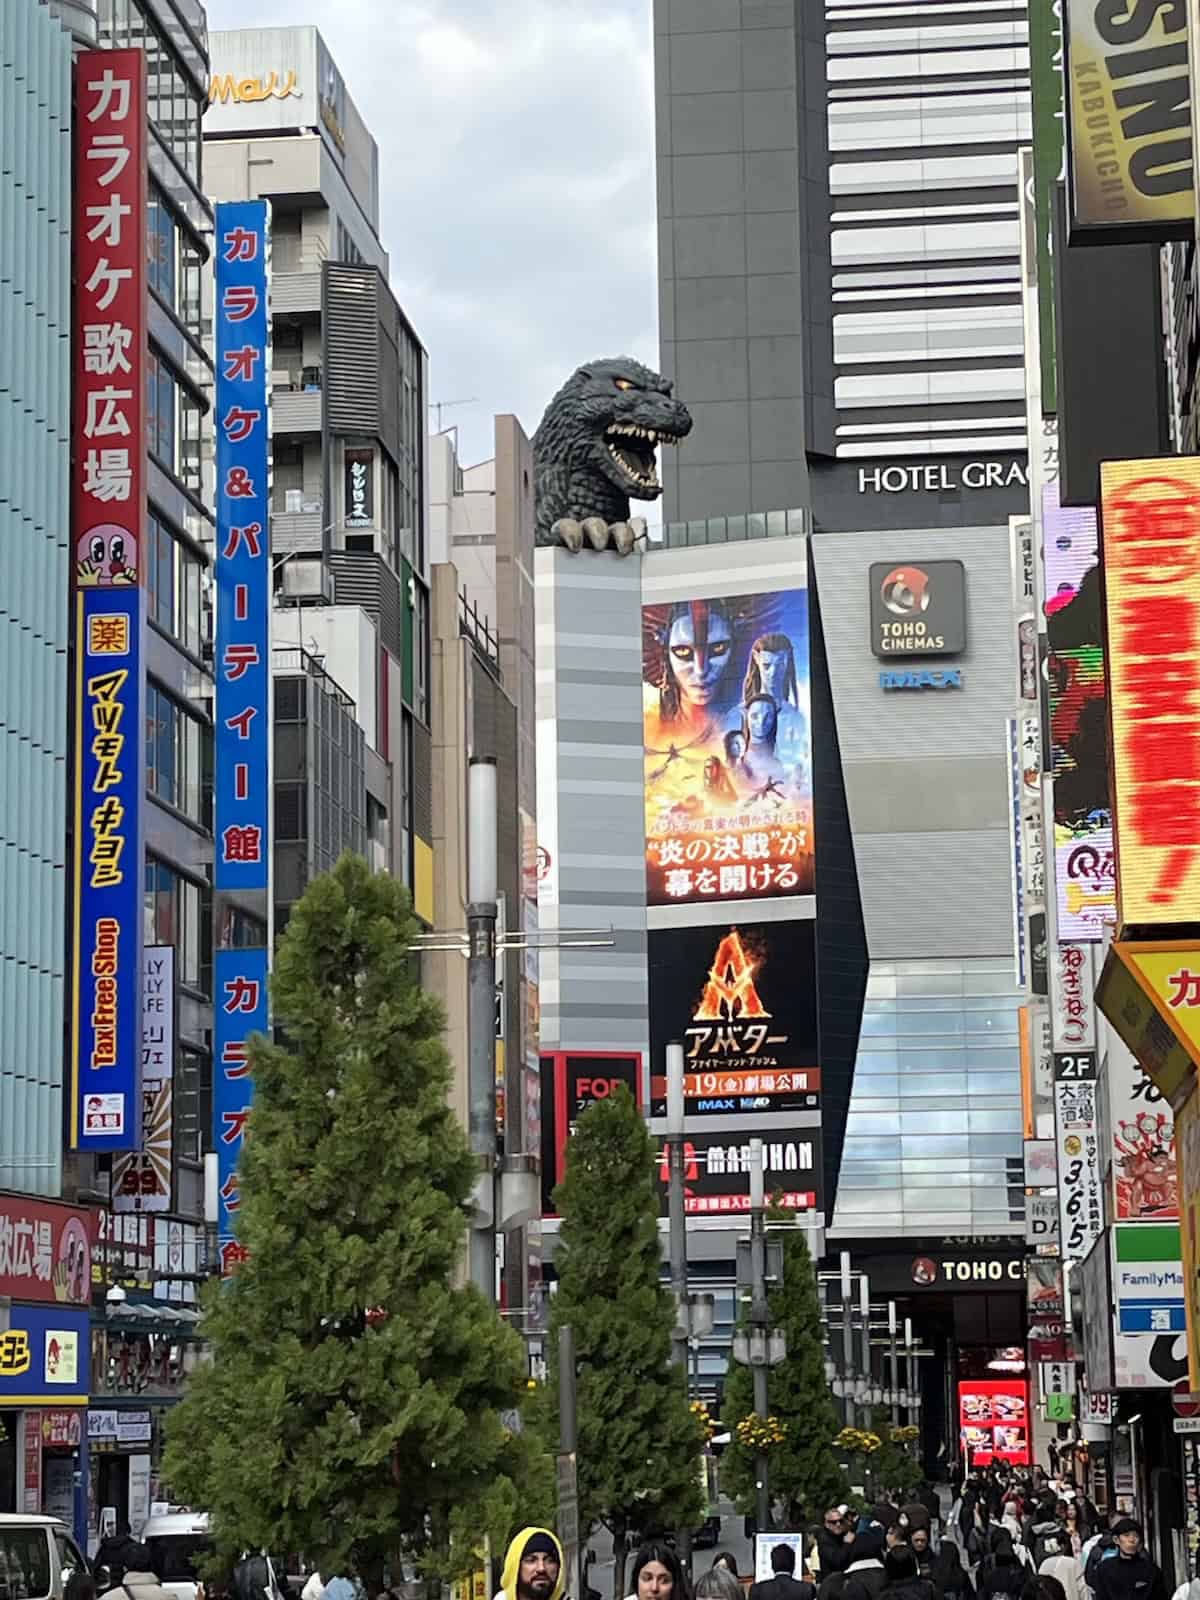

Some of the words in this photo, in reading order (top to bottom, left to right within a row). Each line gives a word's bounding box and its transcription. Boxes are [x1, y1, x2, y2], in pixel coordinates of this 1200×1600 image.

[1074, 61, 1128, 209] KABUKICHO
[83, 68, 134, 504] カラオケ歌広場
[858, 465, 956, 493] HOTEL
[961, 462, 1030, 488] GRA
[222, 226, 261, 863] カラオケ&パーティー館
[92, 618, 125, 652] 薬
[880, 622, 926, 637] TOHO
[881, 636, 945, 650] CINEMAS
[89, 669, 128, 887] マツモトキヨシ
[664, 863, 798, 897] 幕を開ける
[144, 960, 164, 975] LY
[144, 979, 162, 994] LY
[143, 998, 164, 1013] FE
[685, 1025, 788, 1058] アバター
[1060, 1057, 1090, 1077] 2F
[698, 1100, 735, 1111] IMAX
[707, 1142, 812, 1174] MARHAN
[942, 1261, 1002, 1280] TOHO
